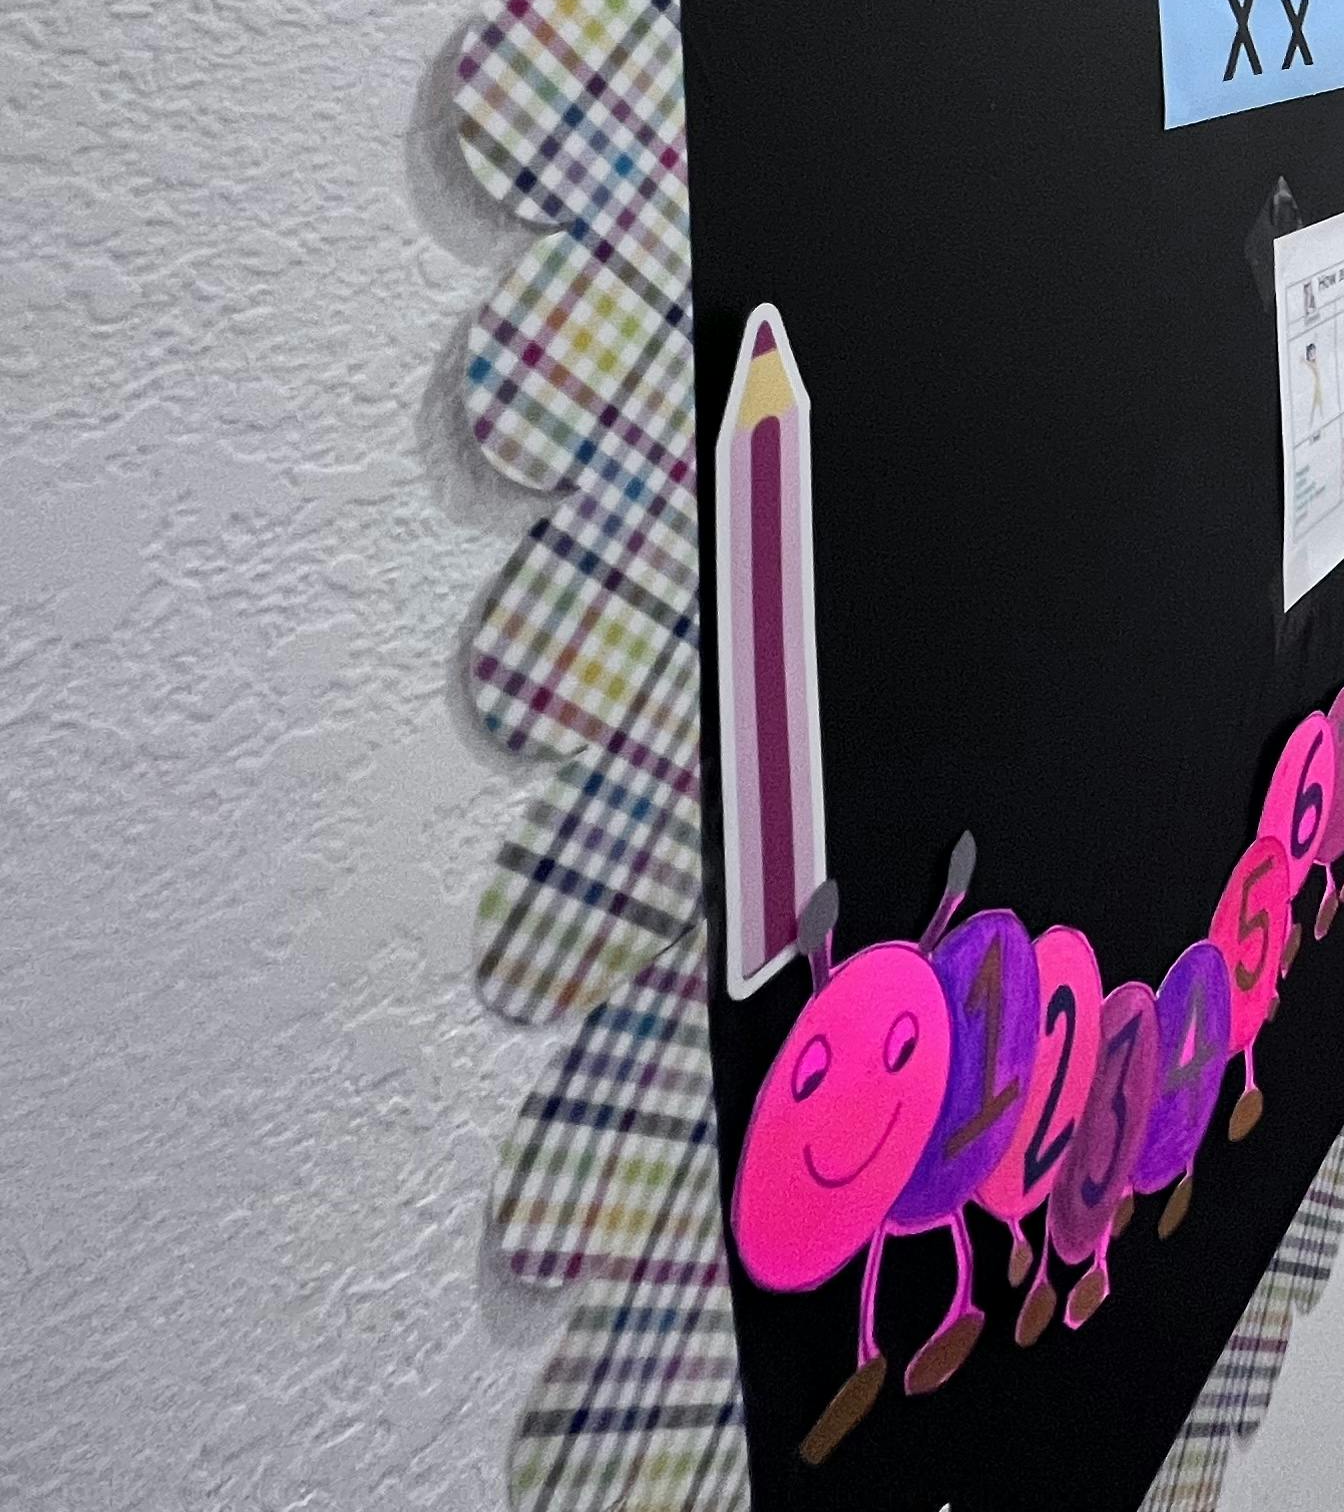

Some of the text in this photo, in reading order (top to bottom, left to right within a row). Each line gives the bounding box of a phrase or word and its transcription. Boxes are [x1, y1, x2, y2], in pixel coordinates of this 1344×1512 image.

[1316, 273, 1337, 292] How
[944, 934, 1020, 1162] 1
[1023, 984, 1076, 1196] 2
[1081, 1010, 1143, 1209] 3
[1164, 980, 1219, 1128] 4
[1235, 854, 1275, 993] 5
[1291, 729, 1324, 860] 6
